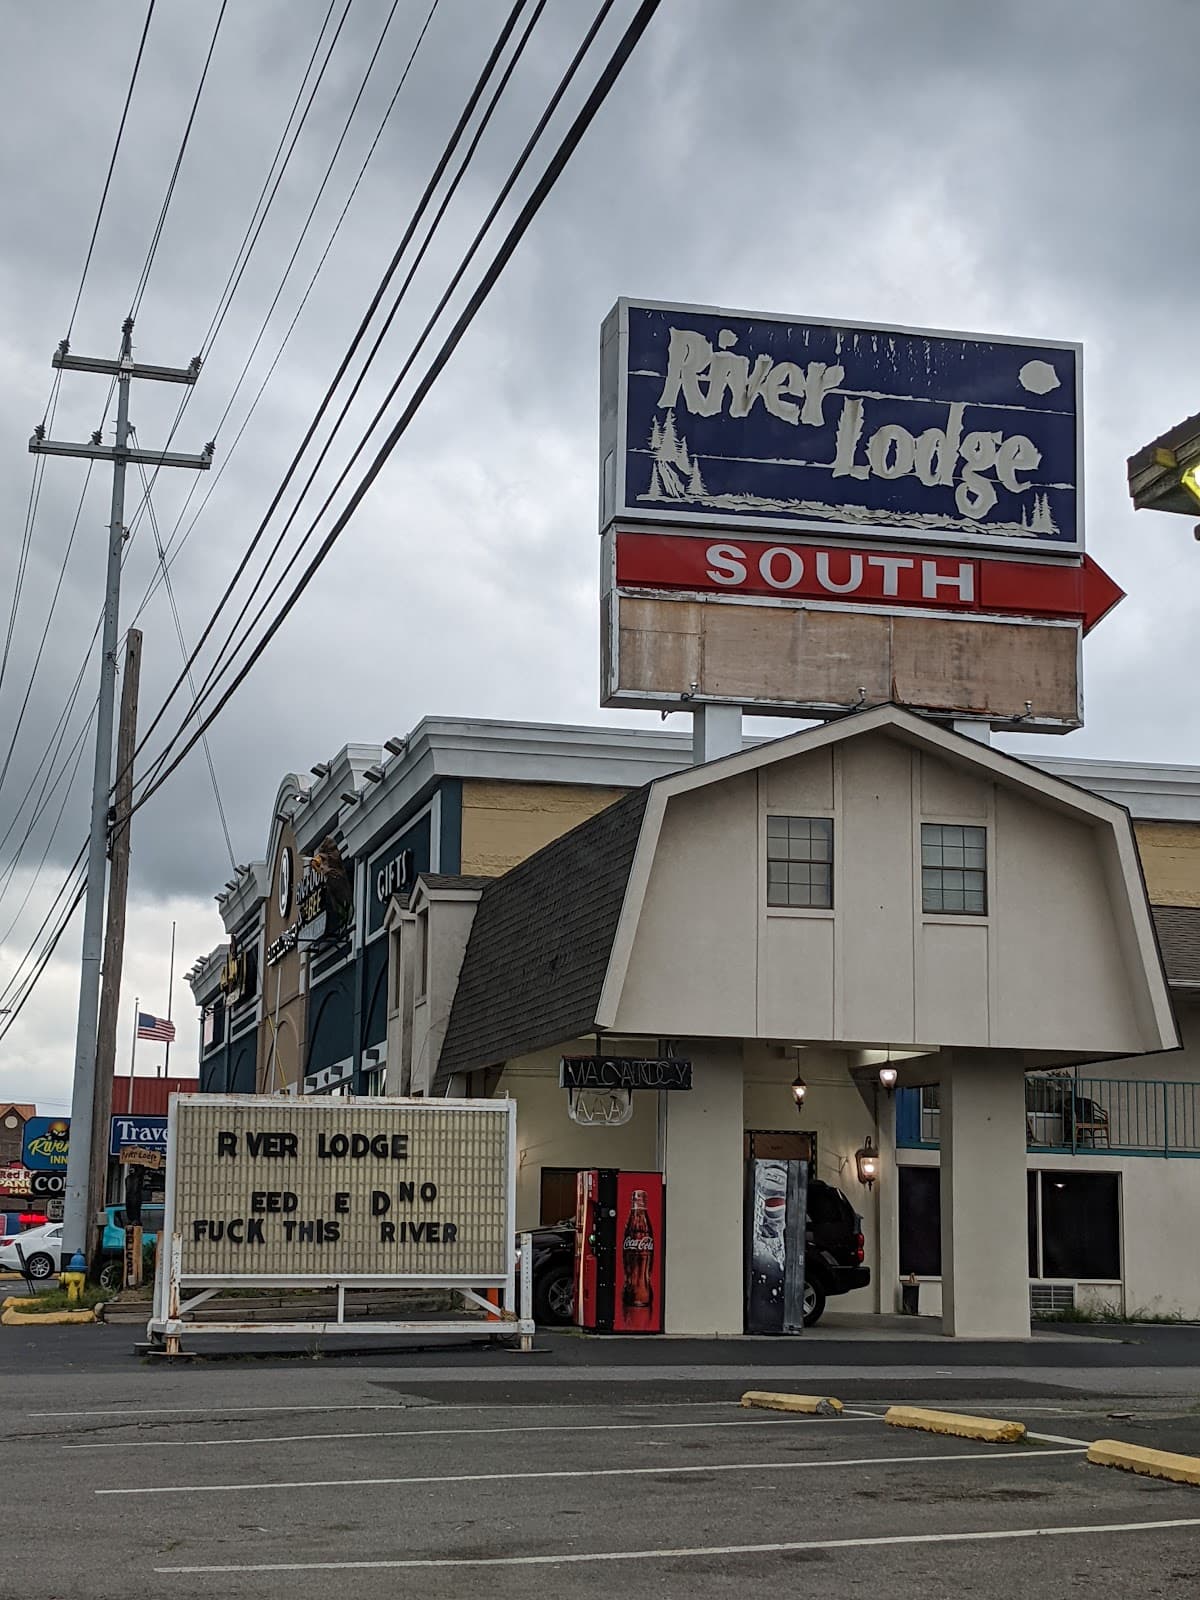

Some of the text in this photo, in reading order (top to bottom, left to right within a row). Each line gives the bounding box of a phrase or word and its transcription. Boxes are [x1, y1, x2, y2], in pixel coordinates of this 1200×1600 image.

[658, 326, 845, 427] River
[832, 397, 1043, 519] Lodge
[705, 543, 975, 603] SOUTH
[377, 850, 407, 902] GIFTS
[318, 1133, 409, 1160] LODGE
[252, 1191, 299, 1213] EED
[400, 1181, 437, 1203] NO
[193, 1218, 458, 1244] FUCK THIS RIVER
